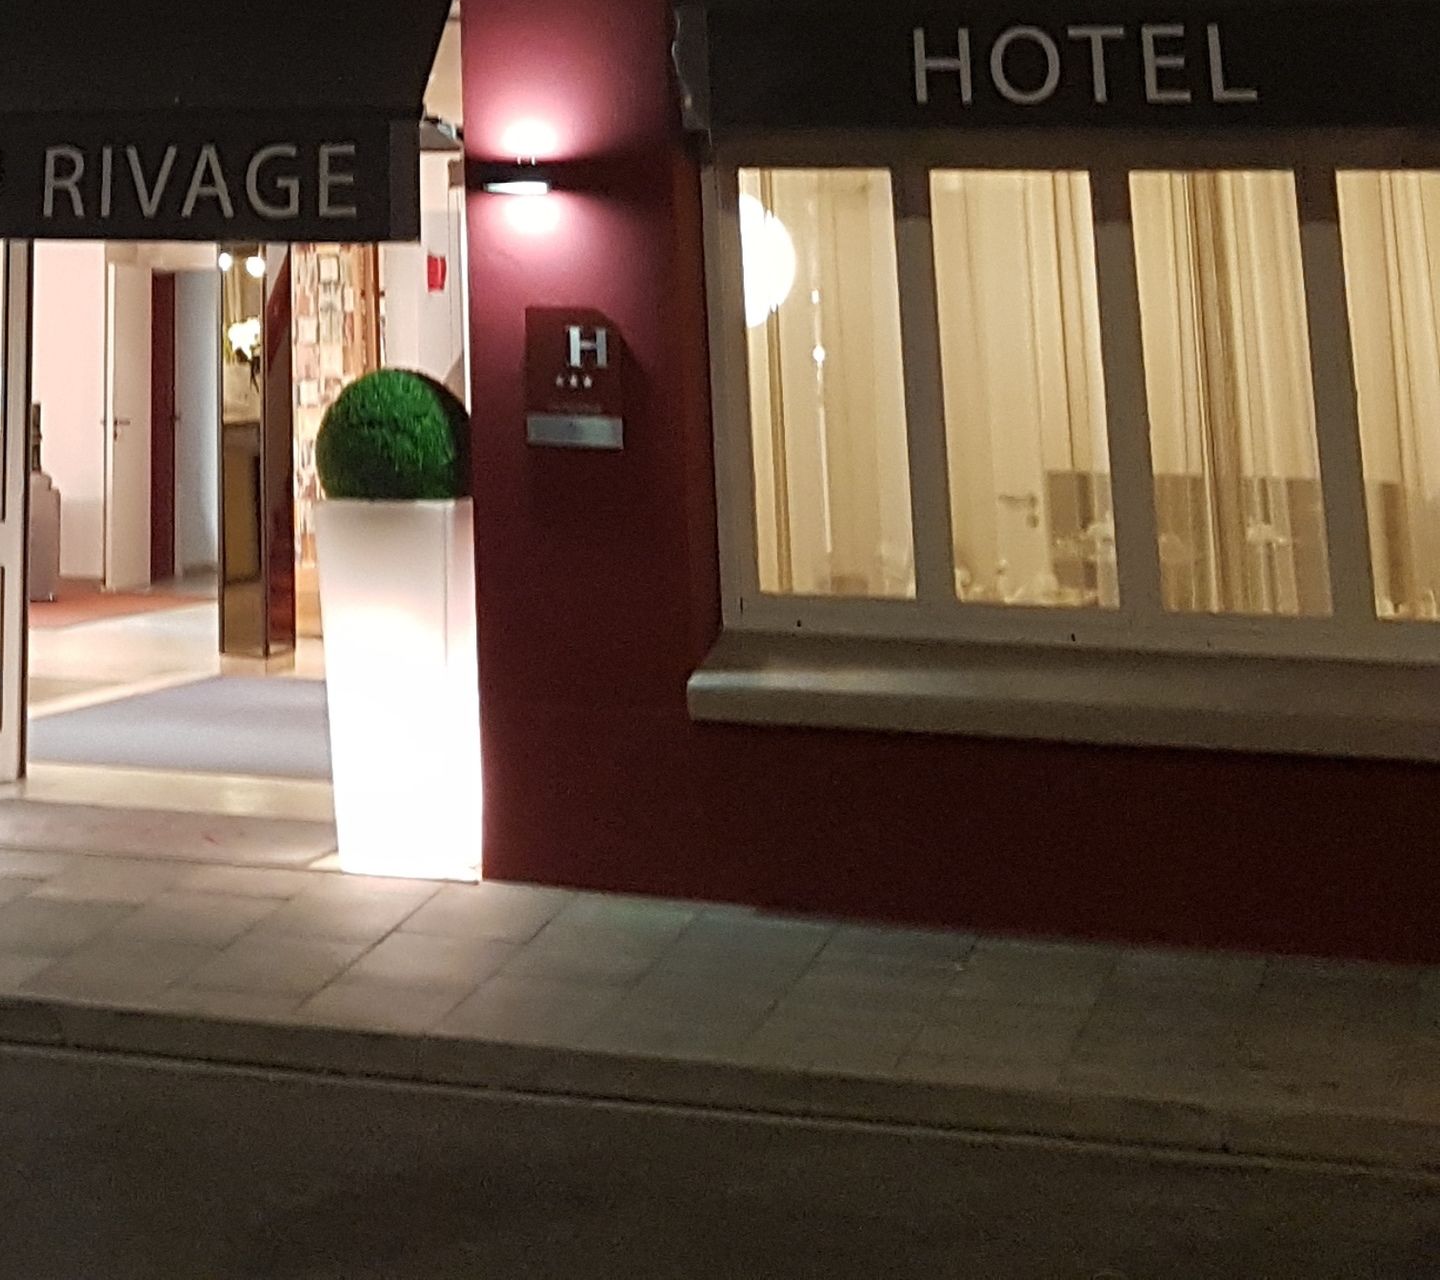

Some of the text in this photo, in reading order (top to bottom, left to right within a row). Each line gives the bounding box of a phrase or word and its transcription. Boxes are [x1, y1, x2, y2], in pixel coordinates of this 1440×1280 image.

[912, 23, 1258, 106] HOTEL
[42, 144, 359, 220] RIVAGE
[567, 325, 609, 369] H
